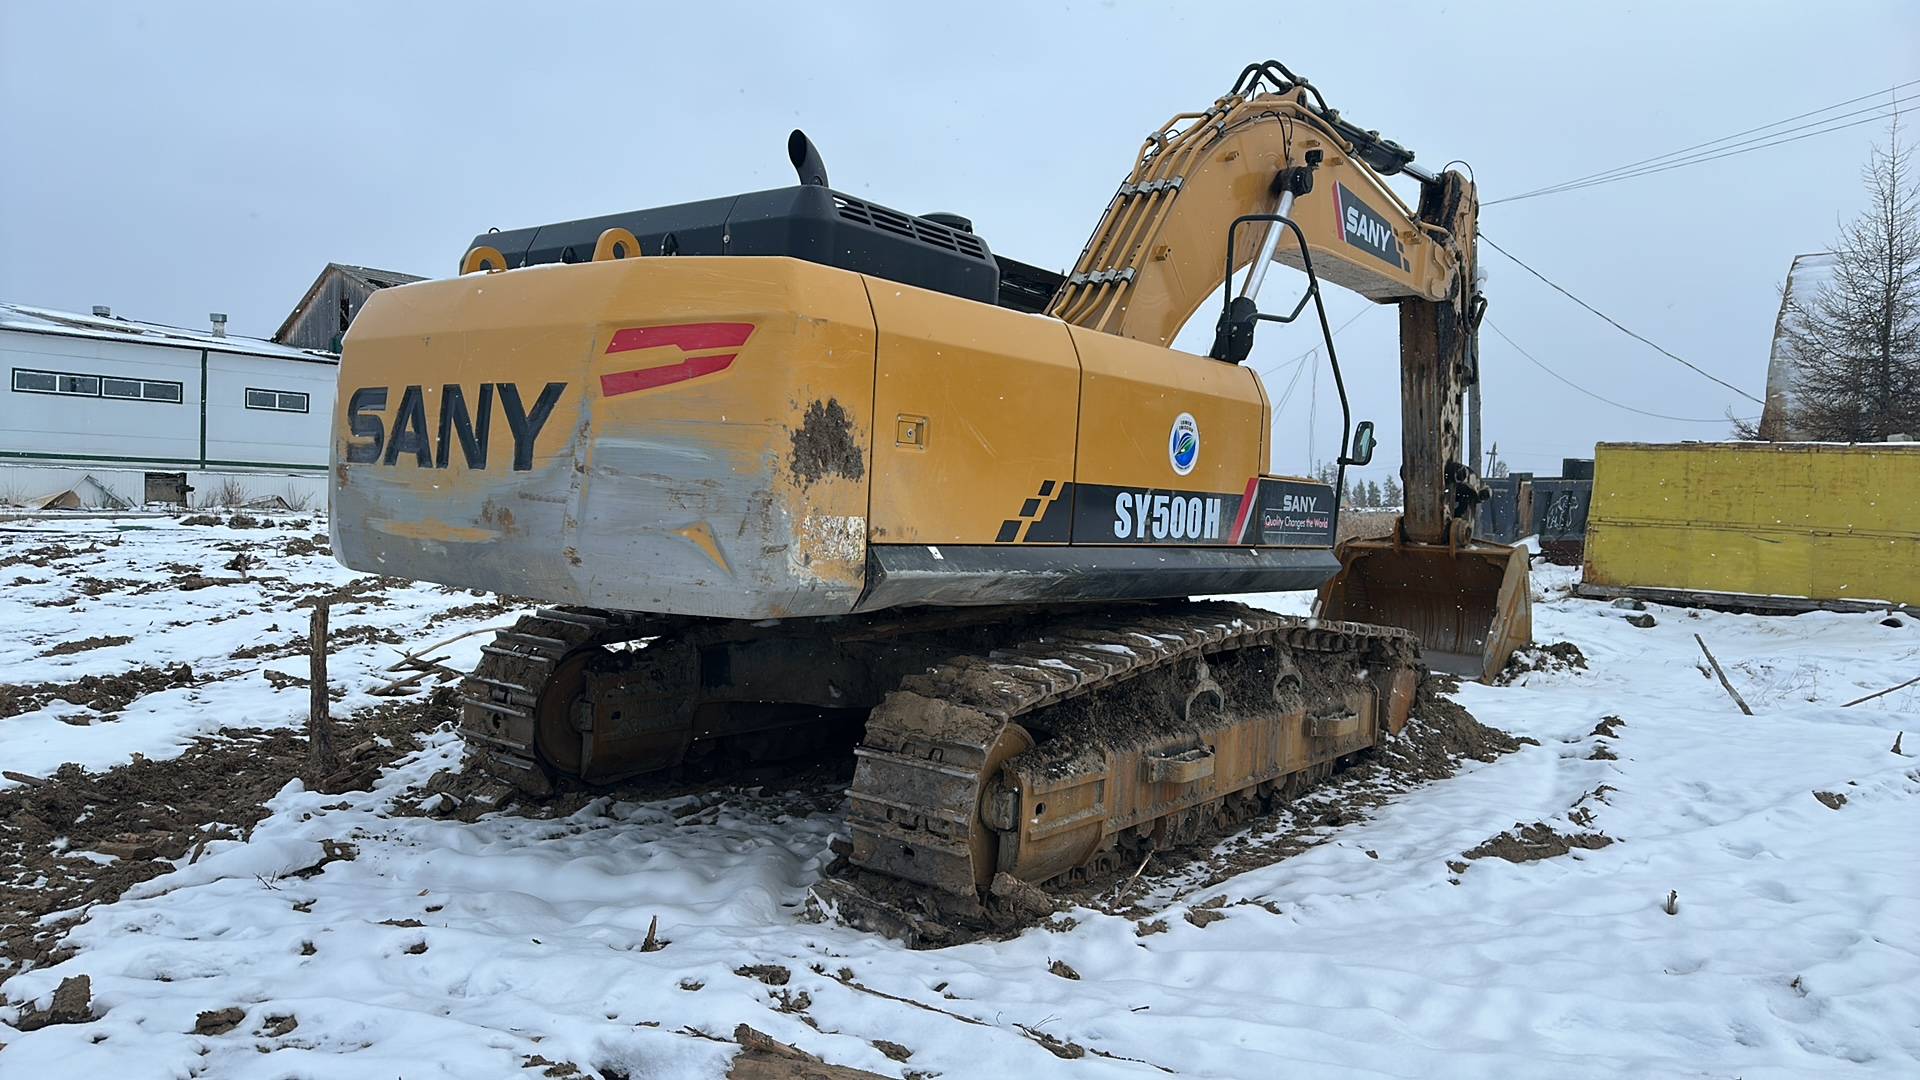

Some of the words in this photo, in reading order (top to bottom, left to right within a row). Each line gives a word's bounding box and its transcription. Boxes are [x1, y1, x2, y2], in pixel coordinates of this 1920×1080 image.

[1346, 206, 1391, 252] SANY
[346, 382, 568, 471] SANY
[1114, 492, 1221, 539] SY500H
[1265, 515, 1283, 530] Quality
[1284, 516, 1305, 530] Changes
[1314, 517, 1328, 528] World
[1283, 495, 1316, 513] SANY
